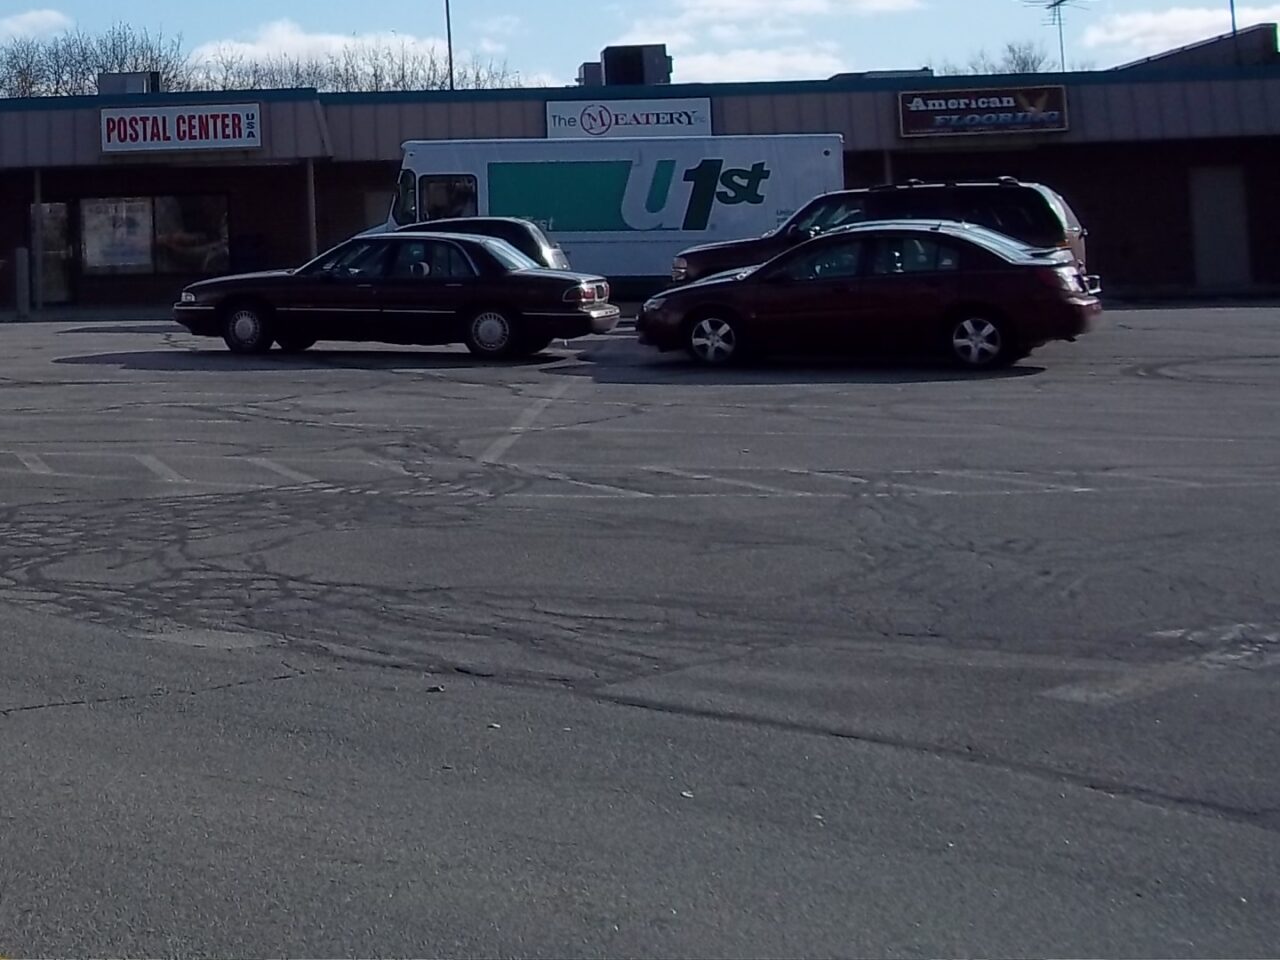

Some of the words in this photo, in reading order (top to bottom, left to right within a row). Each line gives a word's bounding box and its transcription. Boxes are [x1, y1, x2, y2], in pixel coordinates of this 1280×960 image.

[906, 96, 1016, 111] American
[106, 115, 171, 143] POSTAL
[176, 113, 242, 141] CENTER
[246, 113, 255, 138] USA
[551, 114, 577, 127] The
